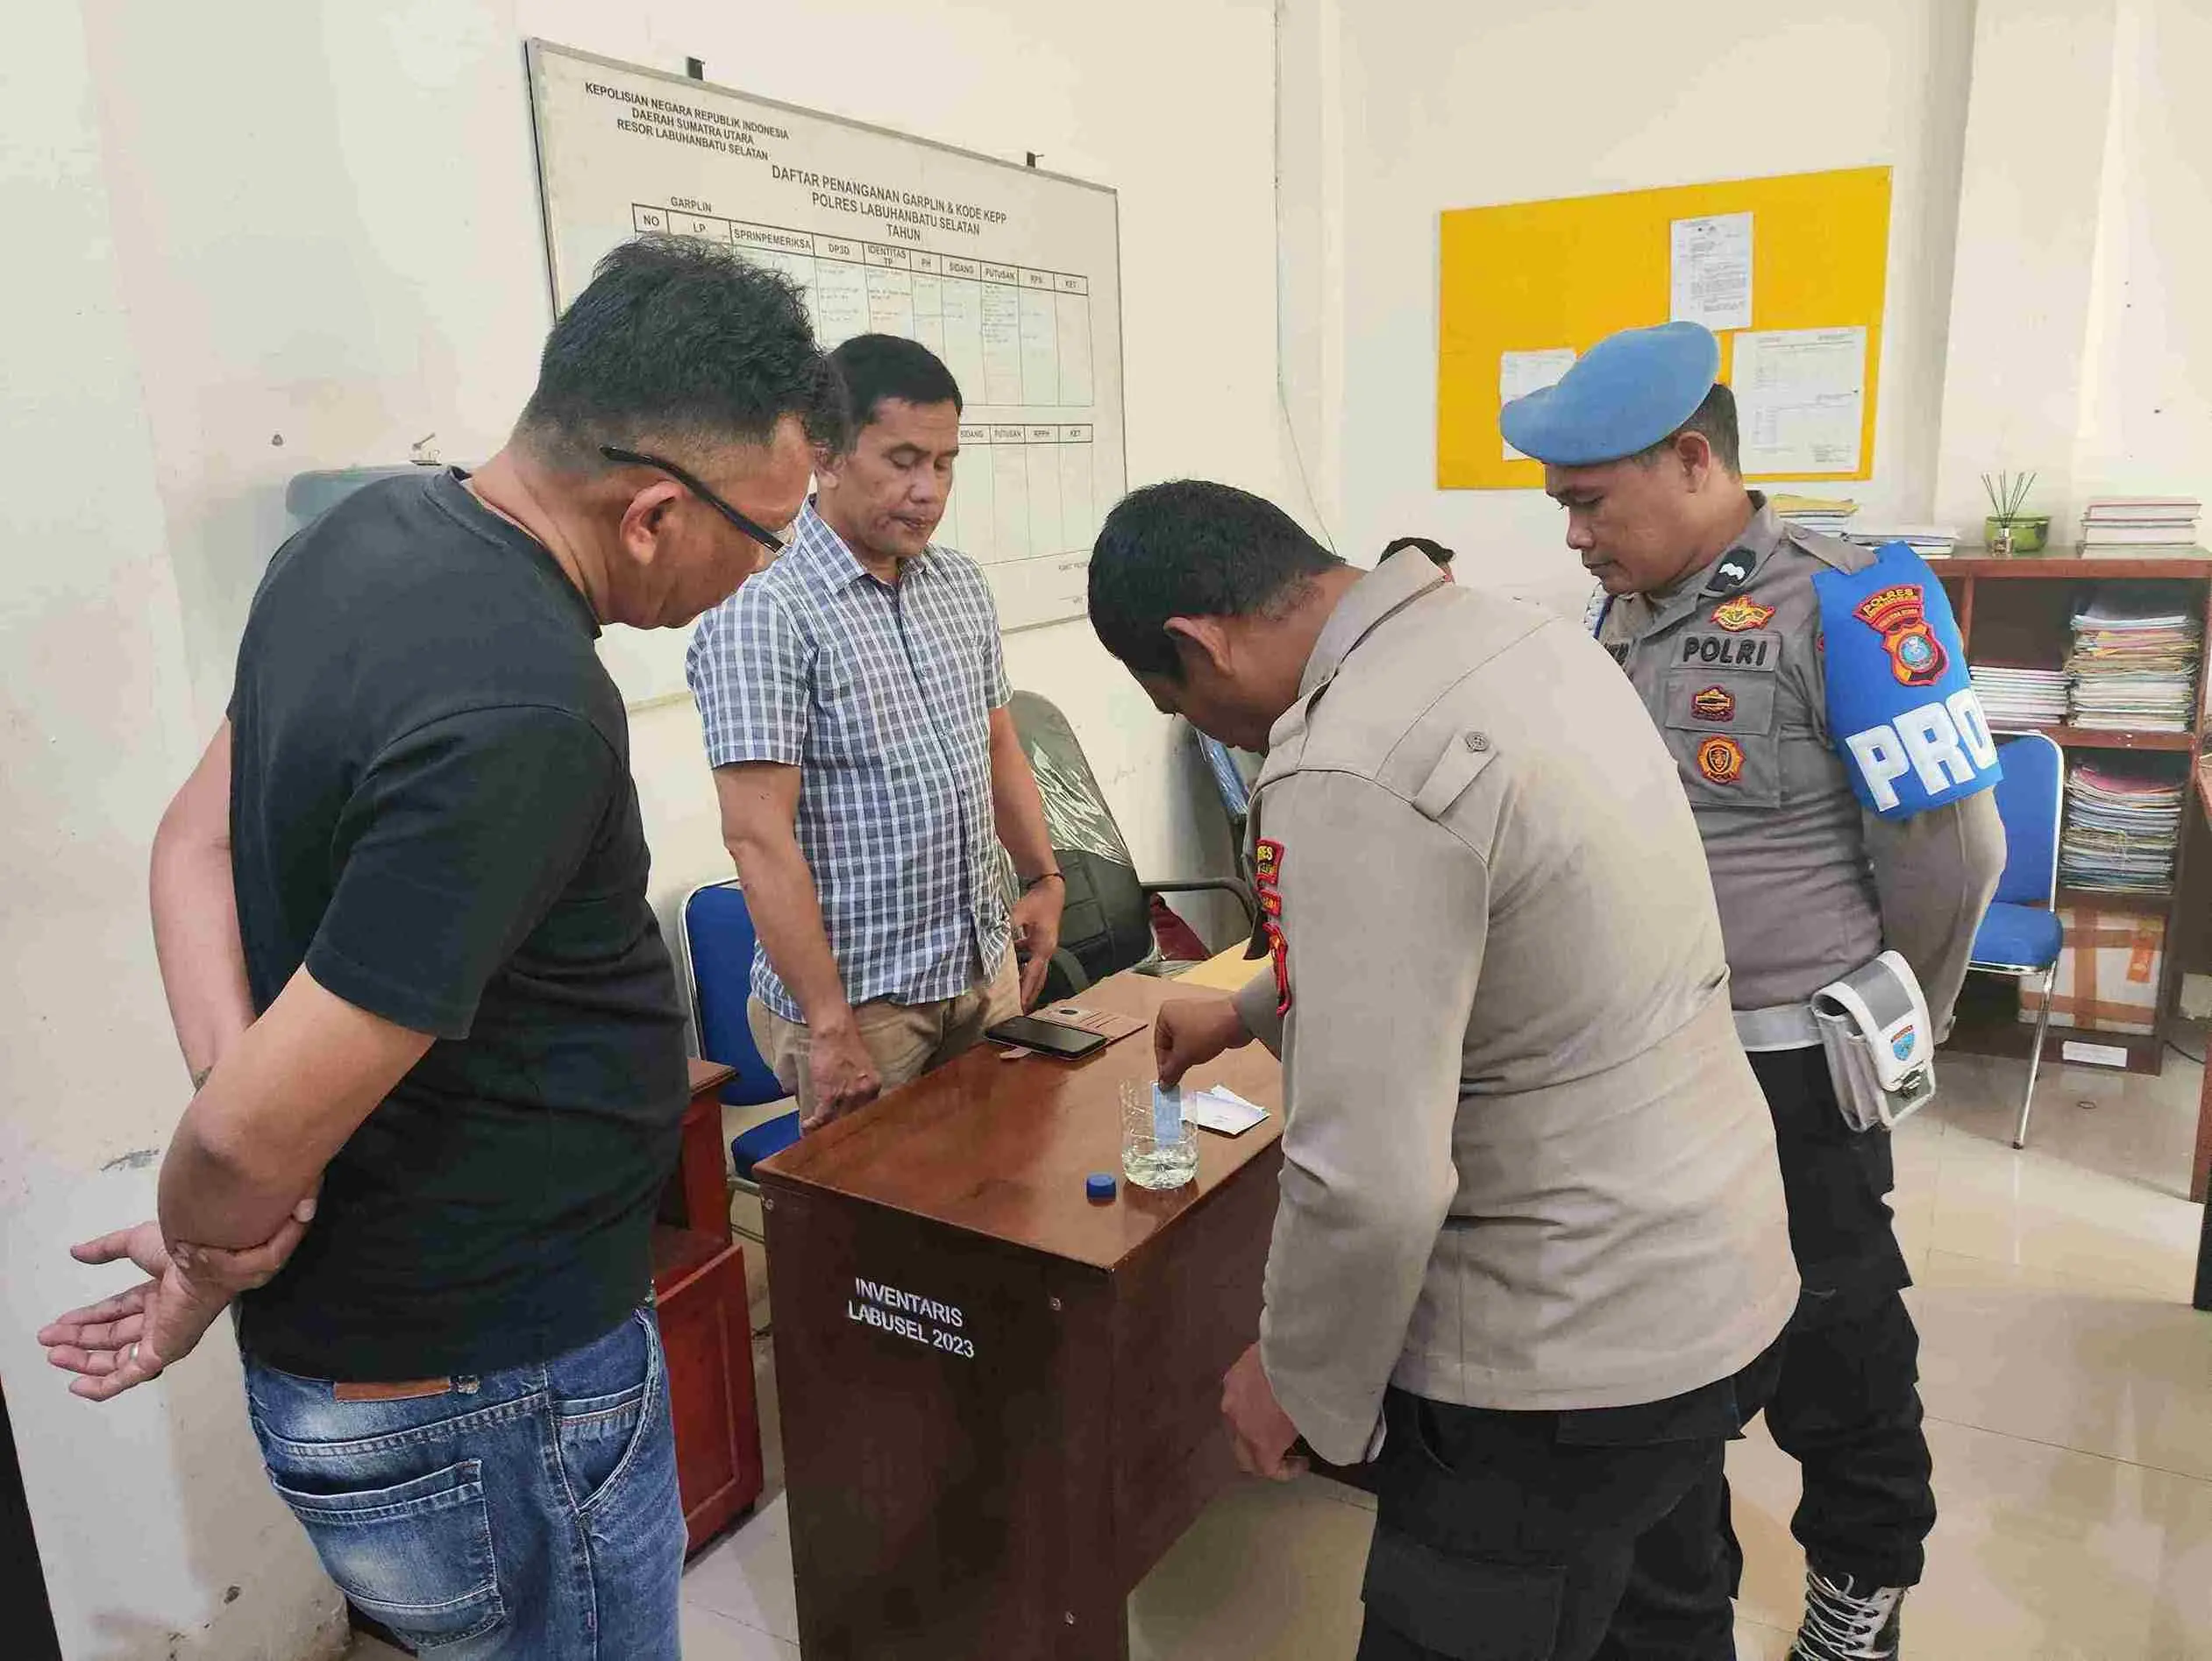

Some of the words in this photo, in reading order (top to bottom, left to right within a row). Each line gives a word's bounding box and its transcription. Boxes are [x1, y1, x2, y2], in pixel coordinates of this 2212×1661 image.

[585, 82, 649, 107] KEPOLISIAN
[651, 99, 693, 117] NEGARA
[694, 109, 740, 129] REPUBLIK
[743, 120, 789, 140] INDONESIA
[631, 107, 674, 127] DAERAH
[676, 117, 722, 138] SUMATRA
[723, 130, 754, 146] UTARA
[617, 119, 653, 137] RESOR
[656, 126, 727, 153] LABUHANBATU
[729, 143, 769, 161] SELATAN
[670, 195, 712, 213] GARPLIN
[772, 165, 820, 187] DAFTAR
[822, 176, 900, 204] PENANGANAN
[902, 192, 945, 213] GARPLIN
[947, 203, 955, 214] &
[956, 204, 982, 220] KODE
[984, 209, 1007, 224] KEPP
[644, 215, 659, 226] NO
[693, 223, 706, 233] LP
[812, 191, 857, 212] POLRES
[859, 202, 938, 228] LABUHANBATU
[939, 217, 980, 237] SELATAN
[734, 228, 812, 251] SPRINPEMERIKSA
[886, 224, 921, 242] TAHUN
[867, 245, 907, 259] IDENTITAS
[1861, 588, 1916, 618] POLRES
[1682, 636, 1767, 666] POLRI
[1845, 688, 2000, 813] PRO
[855, 1276, 964, 1328] INVENTARIS
[848, 1299, 929, 1345] LABUSEL
[932, 1329, 976, 1359] 2023
